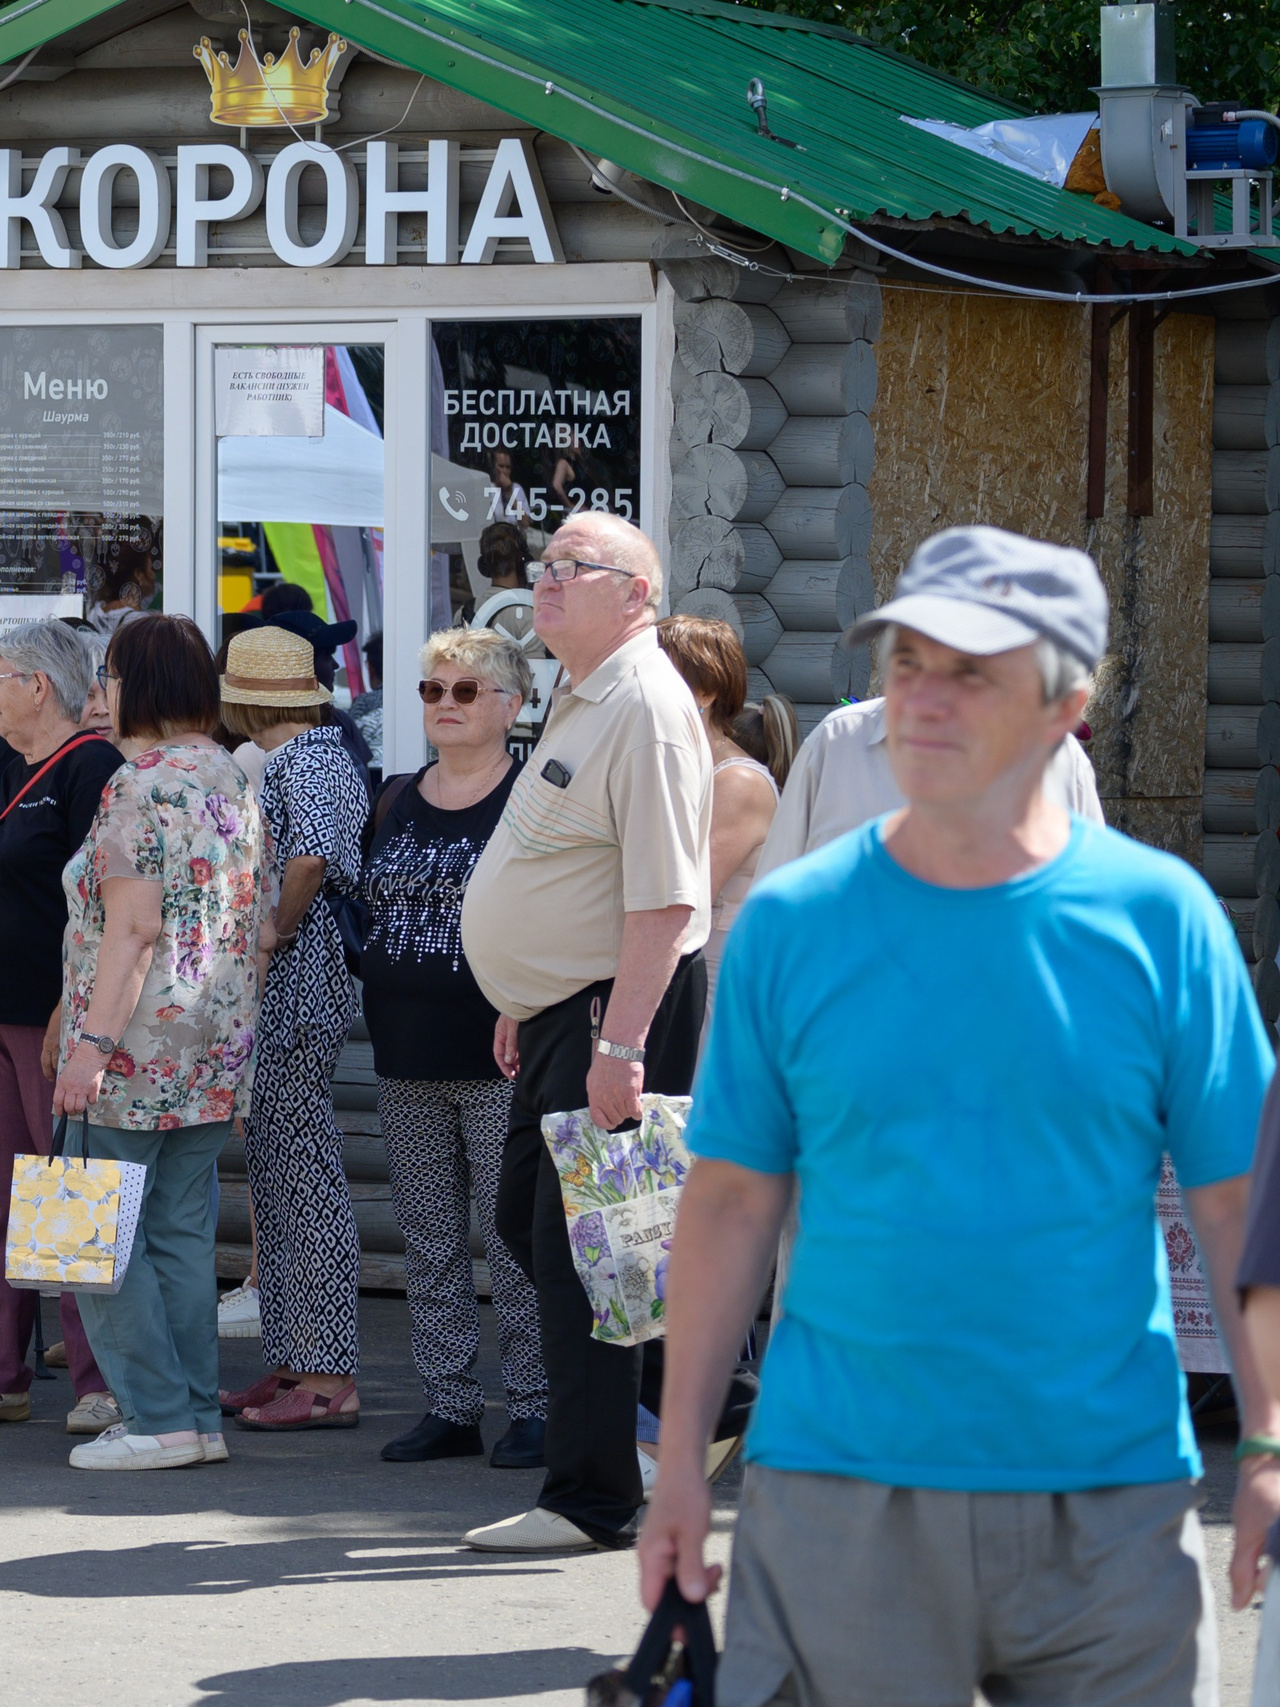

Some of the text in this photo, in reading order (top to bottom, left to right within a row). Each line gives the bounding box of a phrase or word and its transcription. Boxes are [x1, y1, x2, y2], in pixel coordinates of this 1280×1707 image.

[23, 371, 109, 400] Меню
[232, 371, 306, 380] ЕСТЬ СВОБОДНЫЕ
[229, 382, 309, 391] ВАКАНСИИ (НУЖЕН
[246, 393, 293, 402] РАБОТНИК)
[443, 389, 631, 416] БЕСПЛАТНАЯ
[42, 410, 89, 424] Шаурма
[460, 422, 611, 453] ДОСТАВКА
[483, 487, 633, 521] 745-285
